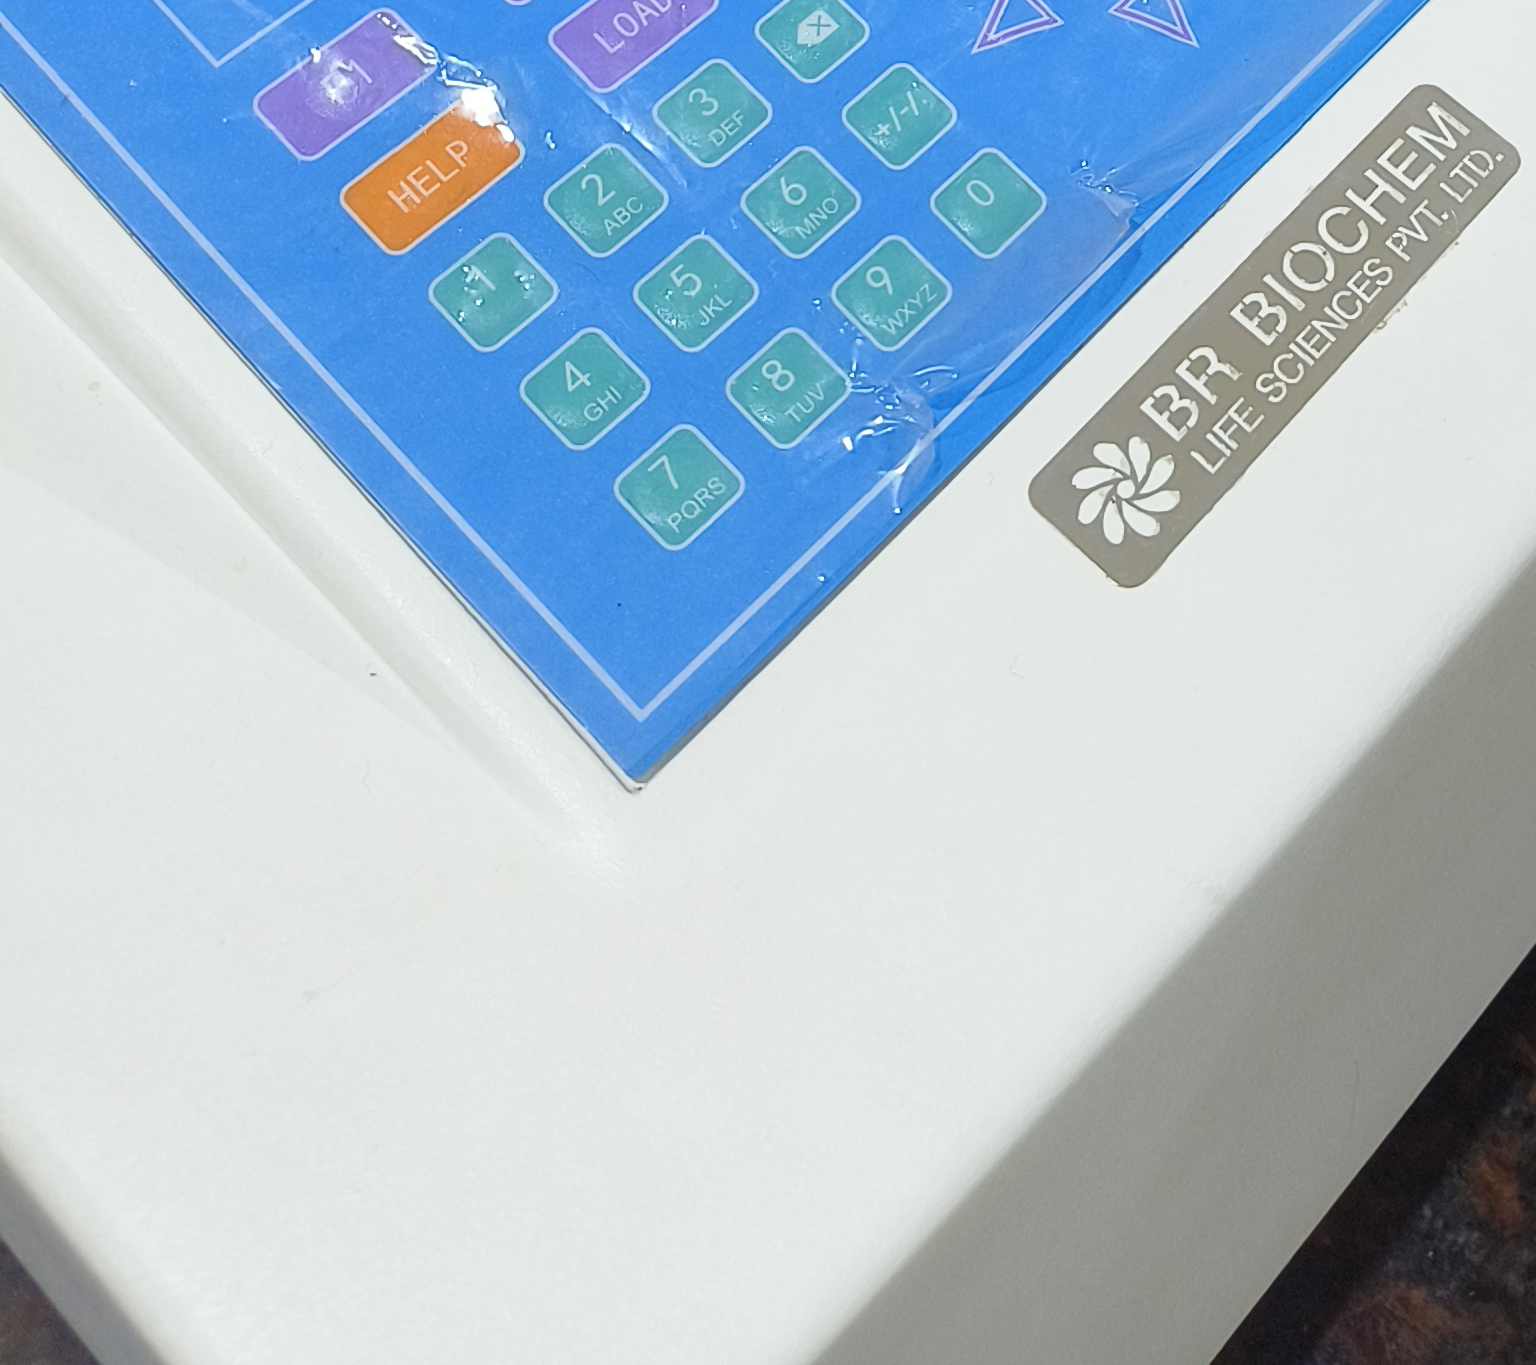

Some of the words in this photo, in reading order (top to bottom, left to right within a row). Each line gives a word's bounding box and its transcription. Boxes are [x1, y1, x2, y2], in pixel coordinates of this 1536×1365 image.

[688, 88, 719, 117] 3
[707, 109, 745, 147] DEF
[387, 139, 470, 213] HELP
[581, 174, 616, 207] 2
[780, 176, 807, 205] 6
[603, 196, 644, 236] ABC
[795, 197, 839, 240] MNO
[669, 264, 702, 296] 5
[865, 266, 893, 296] 9
[1139, 346, 1242, 442] BR
[1229, 101, 1471, 347] BIOCHEM
[700, 293, 733, 326] JKL
[879, 283, 938, 336] WXYZ
[1190, 397, 1265, 475] LIFE
[1255, 258, 1394, 403] SCIENCES
[1385, 199, 1450, 262] PVT.
[1439, 149, 1505, 203] LTD.
[564, 360, 592, 392] 4
[761, 360, 795, 392] 8
[583, 385, 623, 422] GHI
[784, 381, 826, 423] TUV
[647, 455, 679, 490] 7
[667, 477, 727, 534] PQRS
